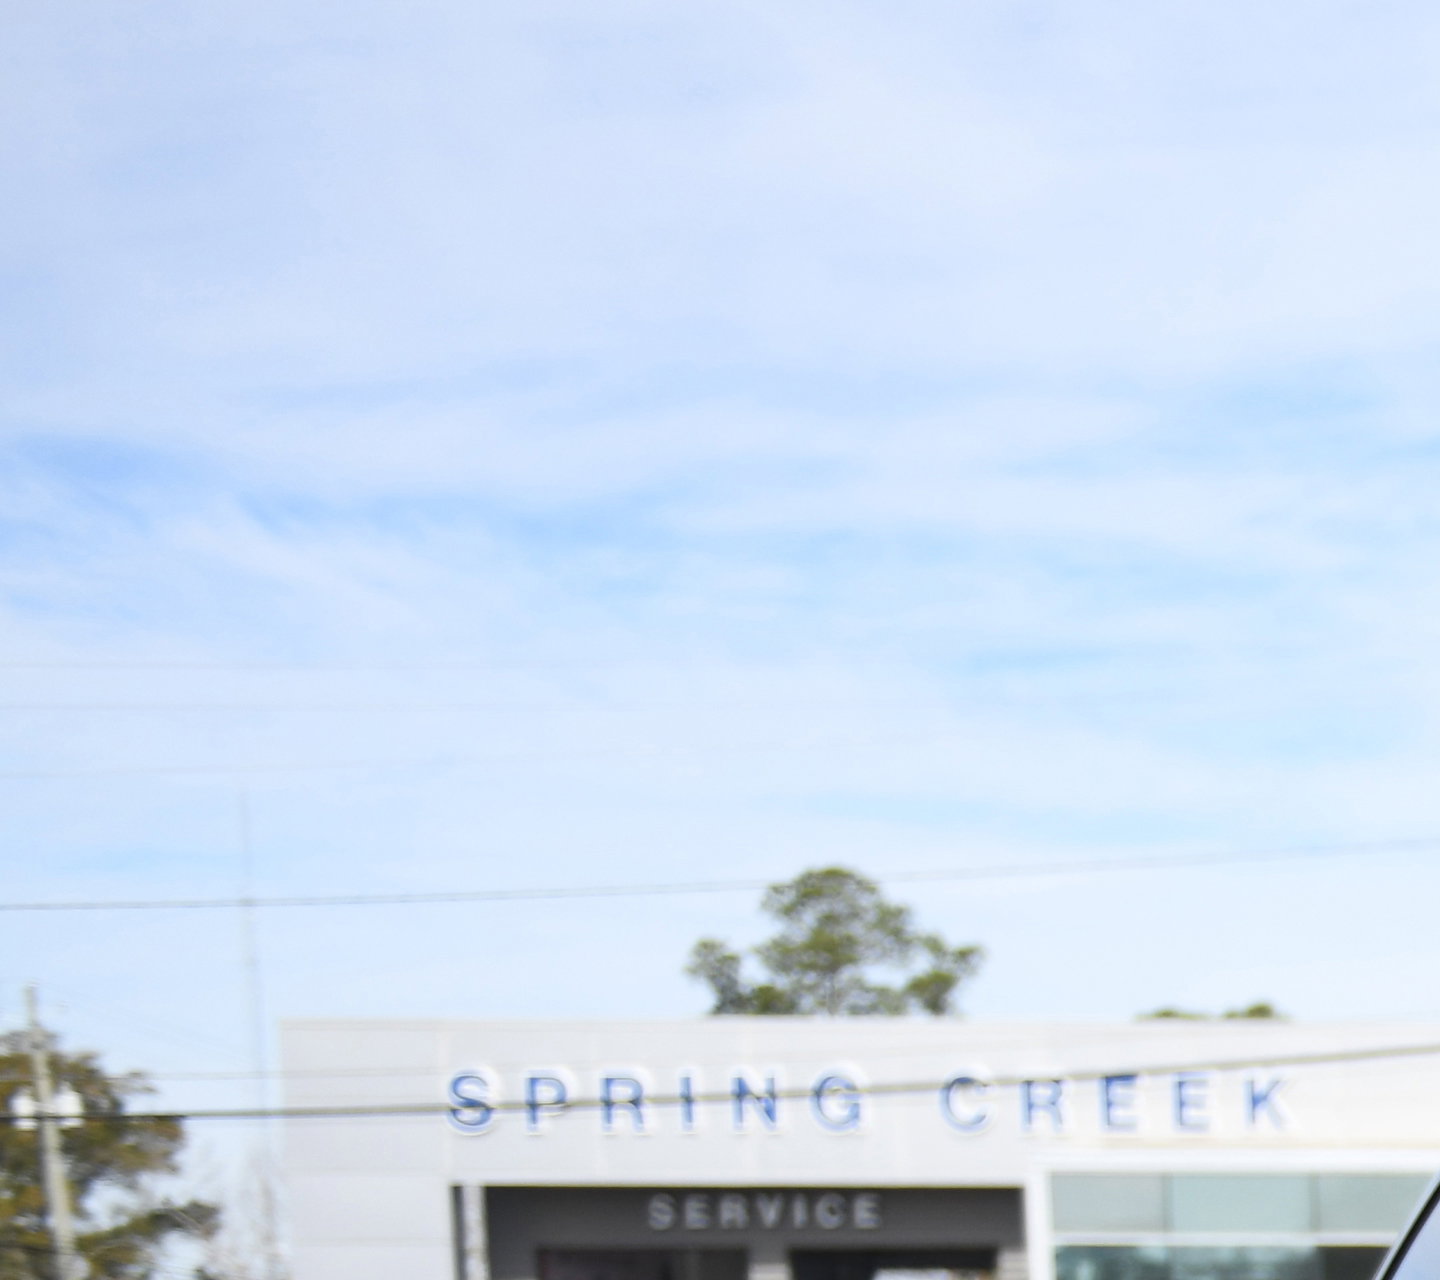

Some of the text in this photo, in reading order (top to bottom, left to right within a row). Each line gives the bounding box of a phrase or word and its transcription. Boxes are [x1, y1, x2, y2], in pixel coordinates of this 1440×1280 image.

[446, 1068, 1297, 1133] SPRING CREEK
[646, 1192, 882, 1234] SERVICE
